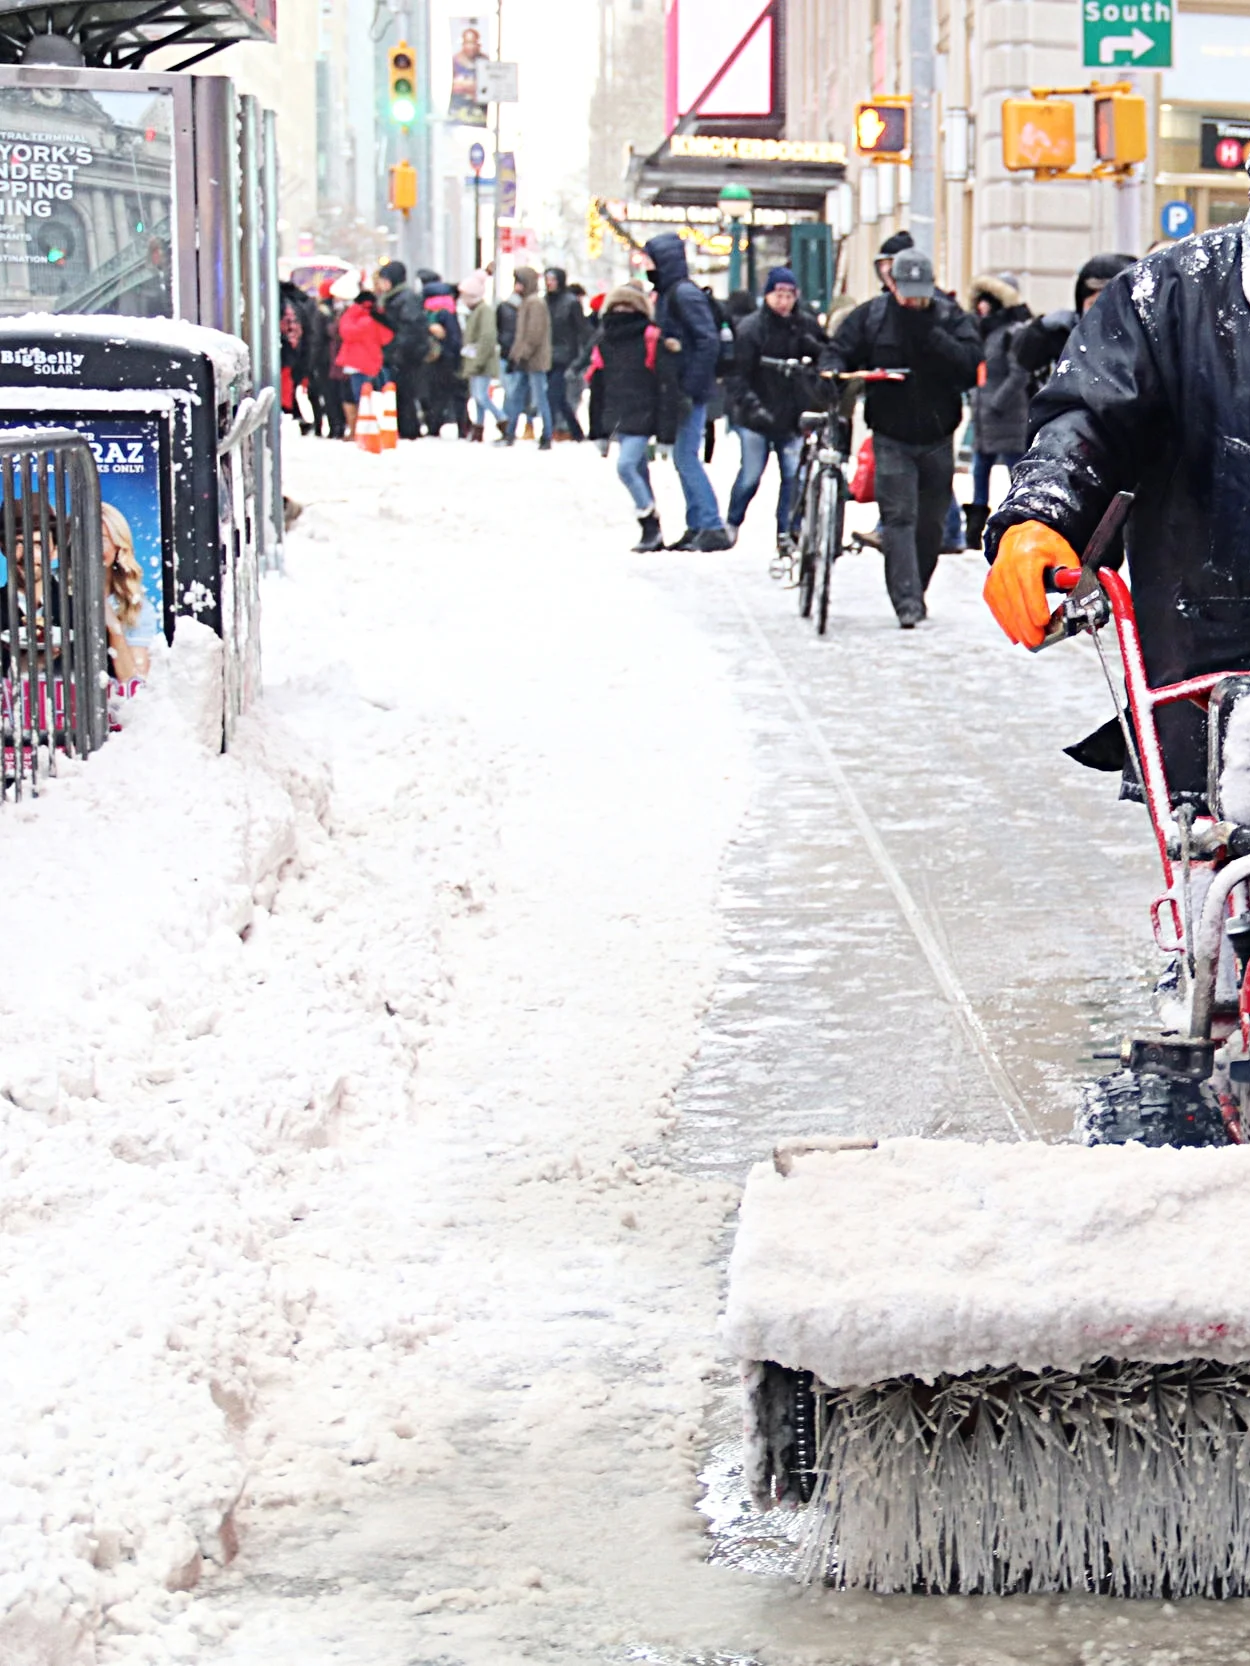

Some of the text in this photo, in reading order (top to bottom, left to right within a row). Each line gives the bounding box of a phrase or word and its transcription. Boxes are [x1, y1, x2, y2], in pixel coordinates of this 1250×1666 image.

[1084, 2, 1171, 22] South
[0, 144, 93, 164] YORK'S
[0, 349, 84, 367] BigBelly
[34, 364, 74, 375] SOLAR
[112, 465, 145, 473] ONLY!
